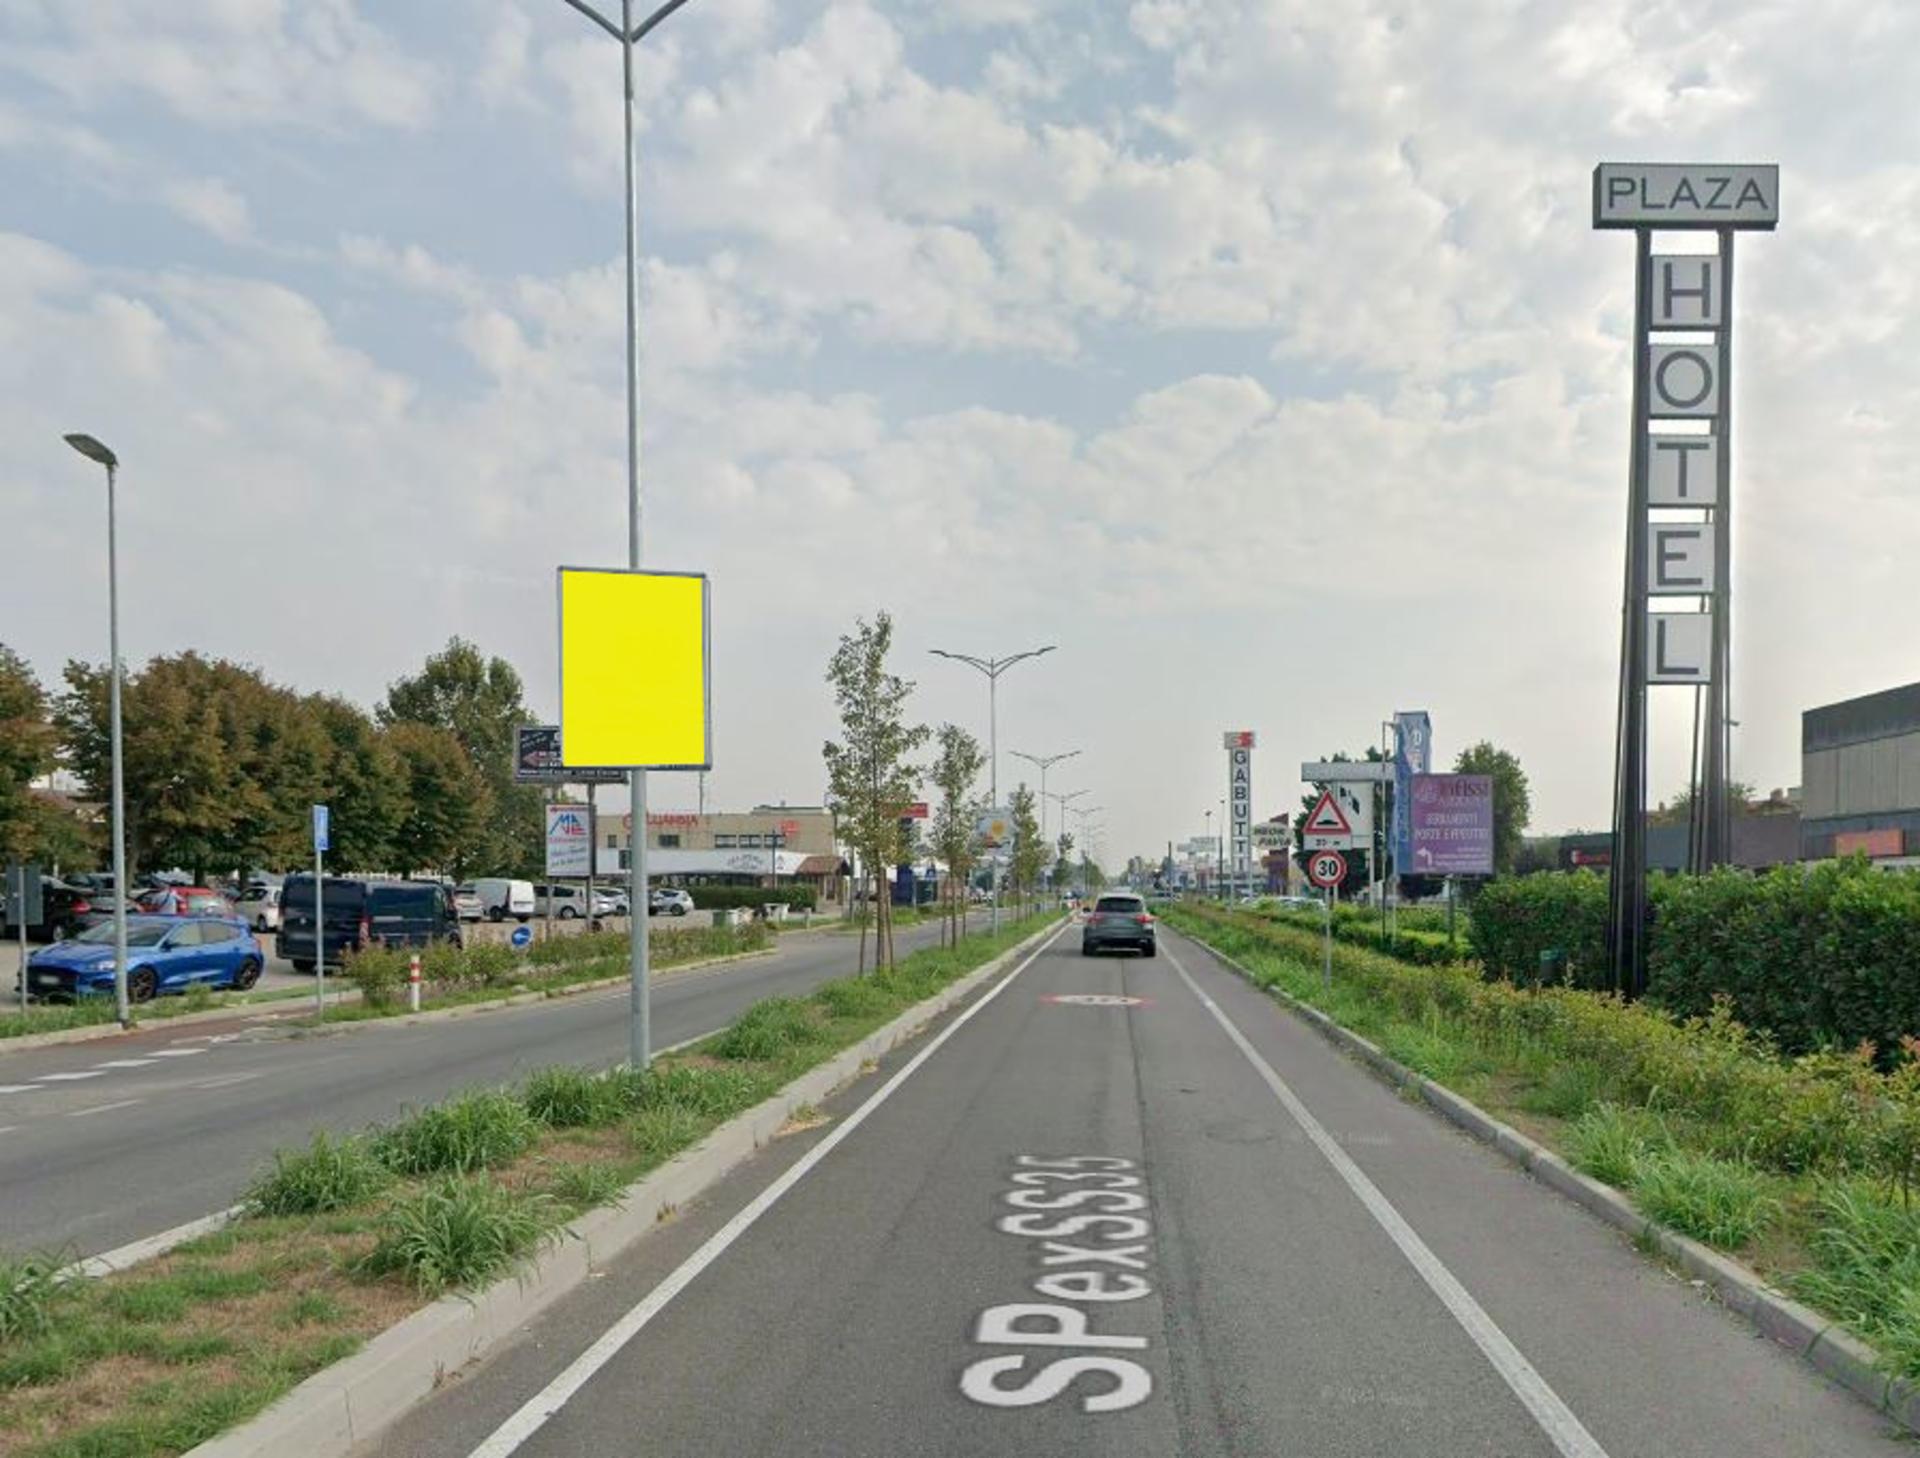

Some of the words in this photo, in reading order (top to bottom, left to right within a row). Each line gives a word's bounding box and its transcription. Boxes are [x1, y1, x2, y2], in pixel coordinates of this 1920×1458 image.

[1608, 176, 1769, 210] PLAZA
[1654, 262, 1713, 676] HOTEL
[1233, 750, 1247, 871] GABUTTI
[1318, 860, 1338, 877] 30
